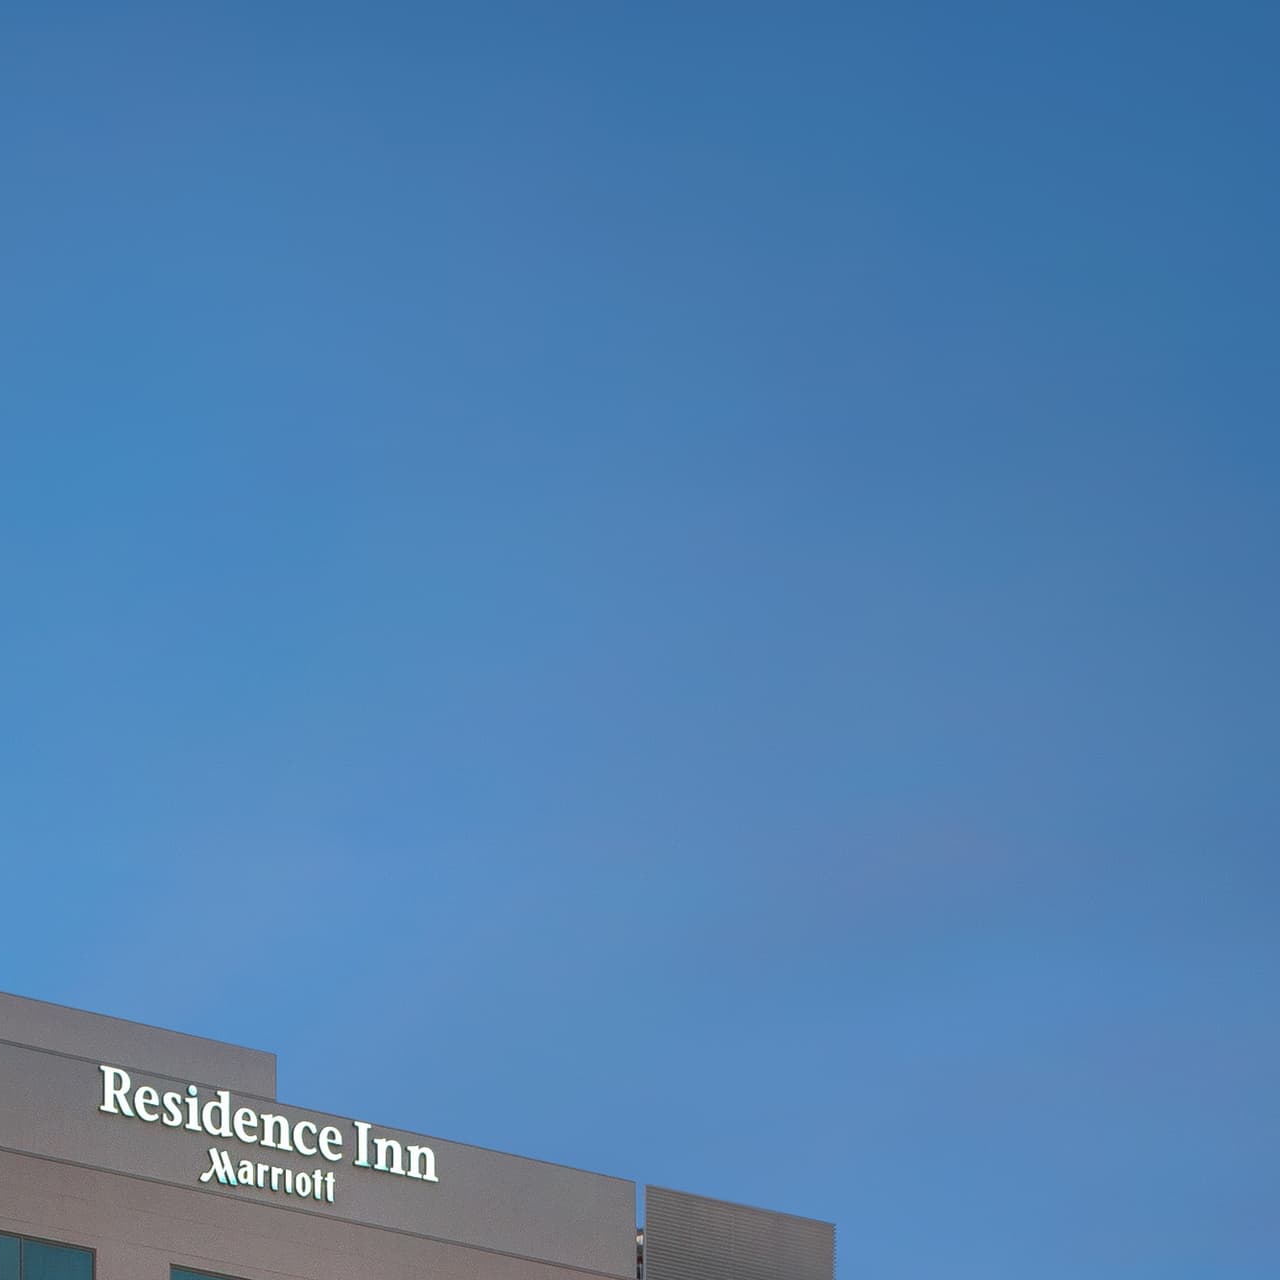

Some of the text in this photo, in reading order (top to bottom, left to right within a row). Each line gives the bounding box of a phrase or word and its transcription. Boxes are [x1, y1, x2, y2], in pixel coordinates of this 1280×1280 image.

[98, 1064, 440, 1183] Residence Inn
[199, 1147, 336, 1203] Marriott
